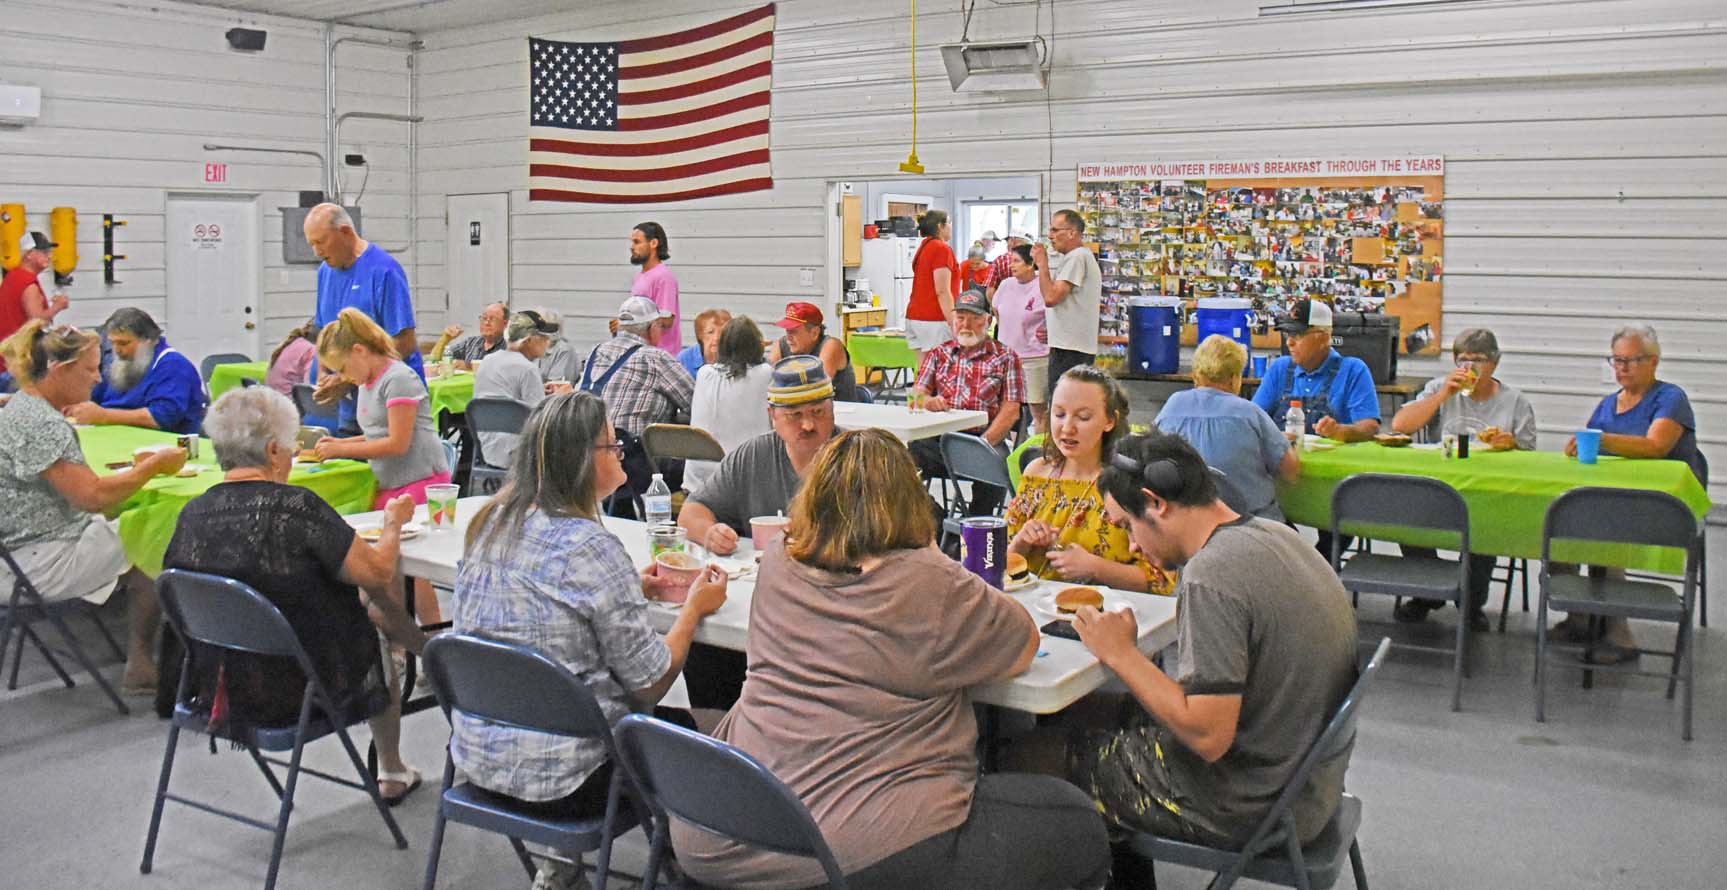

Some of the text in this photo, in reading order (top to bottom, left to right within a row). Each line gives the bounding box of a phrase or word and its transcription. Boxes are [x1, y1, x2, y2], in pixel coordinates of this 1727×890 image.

[204, 163, 227, 182] EXIT
[1080, 158, 1442, 177] NEW HAMPTON VOLUNTEER FIREMAN'S BREAKFAST THROUGH THE YEARS
